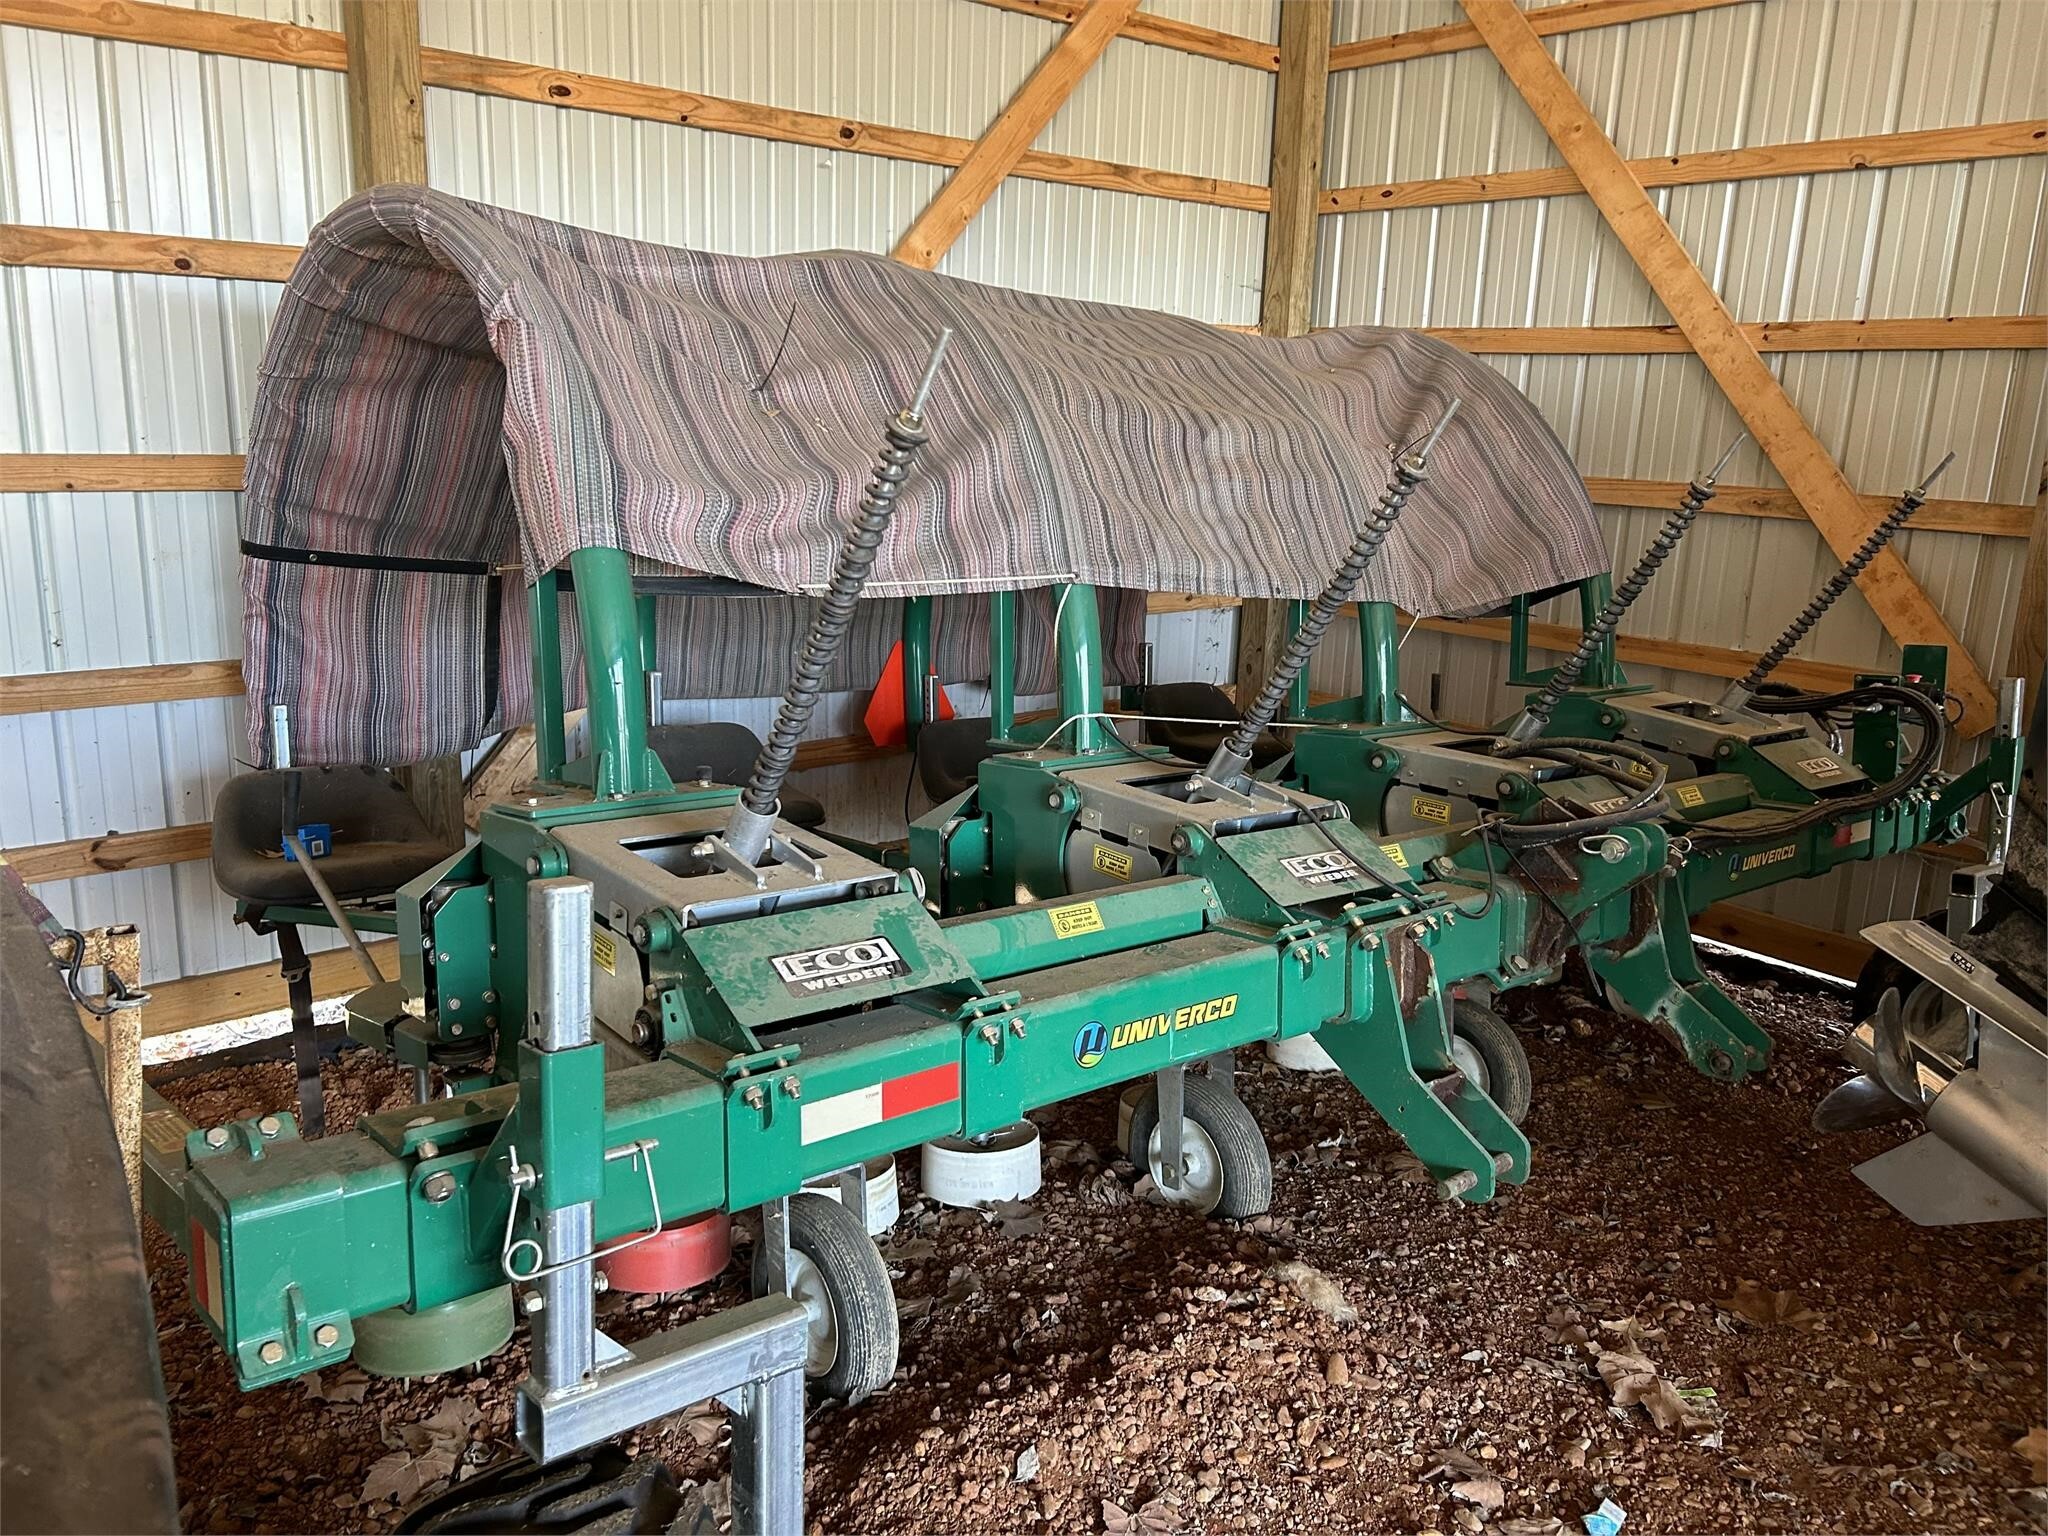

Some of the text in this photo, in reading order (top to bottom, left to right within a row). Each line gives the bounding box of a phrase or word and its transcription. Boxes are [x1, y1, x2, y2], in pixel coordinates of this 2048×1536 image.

[1287, 853, 1348, 875] ECO
[1742, 844, 1796, 871] UNIVERCO
[1306, 869, 1360, 884] WEEDER
[785, 944, 883, 977] ECO
[801, 966, 892, 991] WEEDER
[1110, 993, 1239, 1051] UNIVERCO
